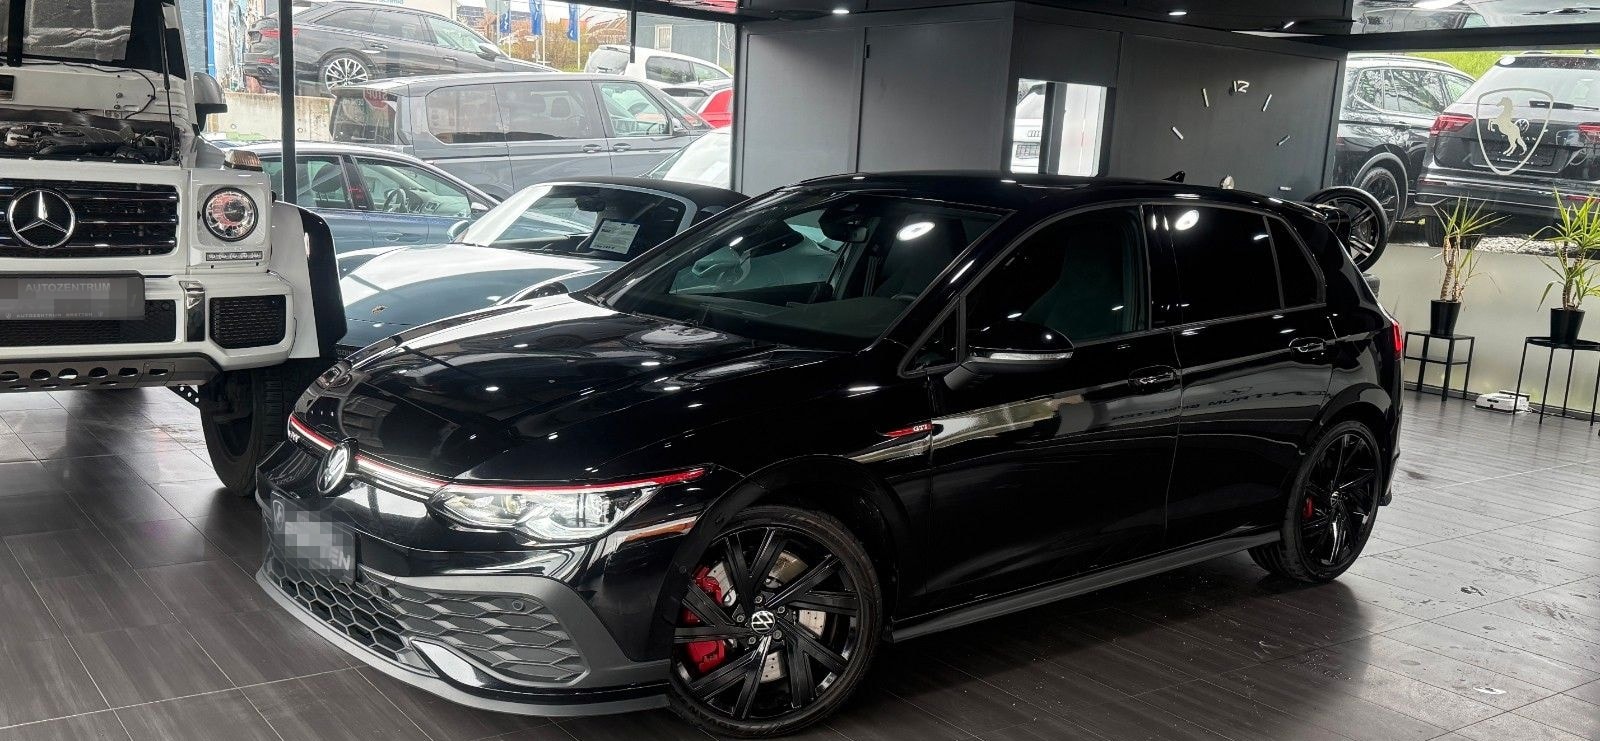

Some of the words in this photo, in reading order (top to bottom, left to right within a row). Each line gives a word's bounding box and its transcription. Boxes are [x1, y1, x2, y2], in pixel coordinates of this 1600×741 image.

[1233, 80, 1250, 93] 12
[25, 282, 111, 293] AUTOZENTRUM
[912, 424, 928, 433] GTI
